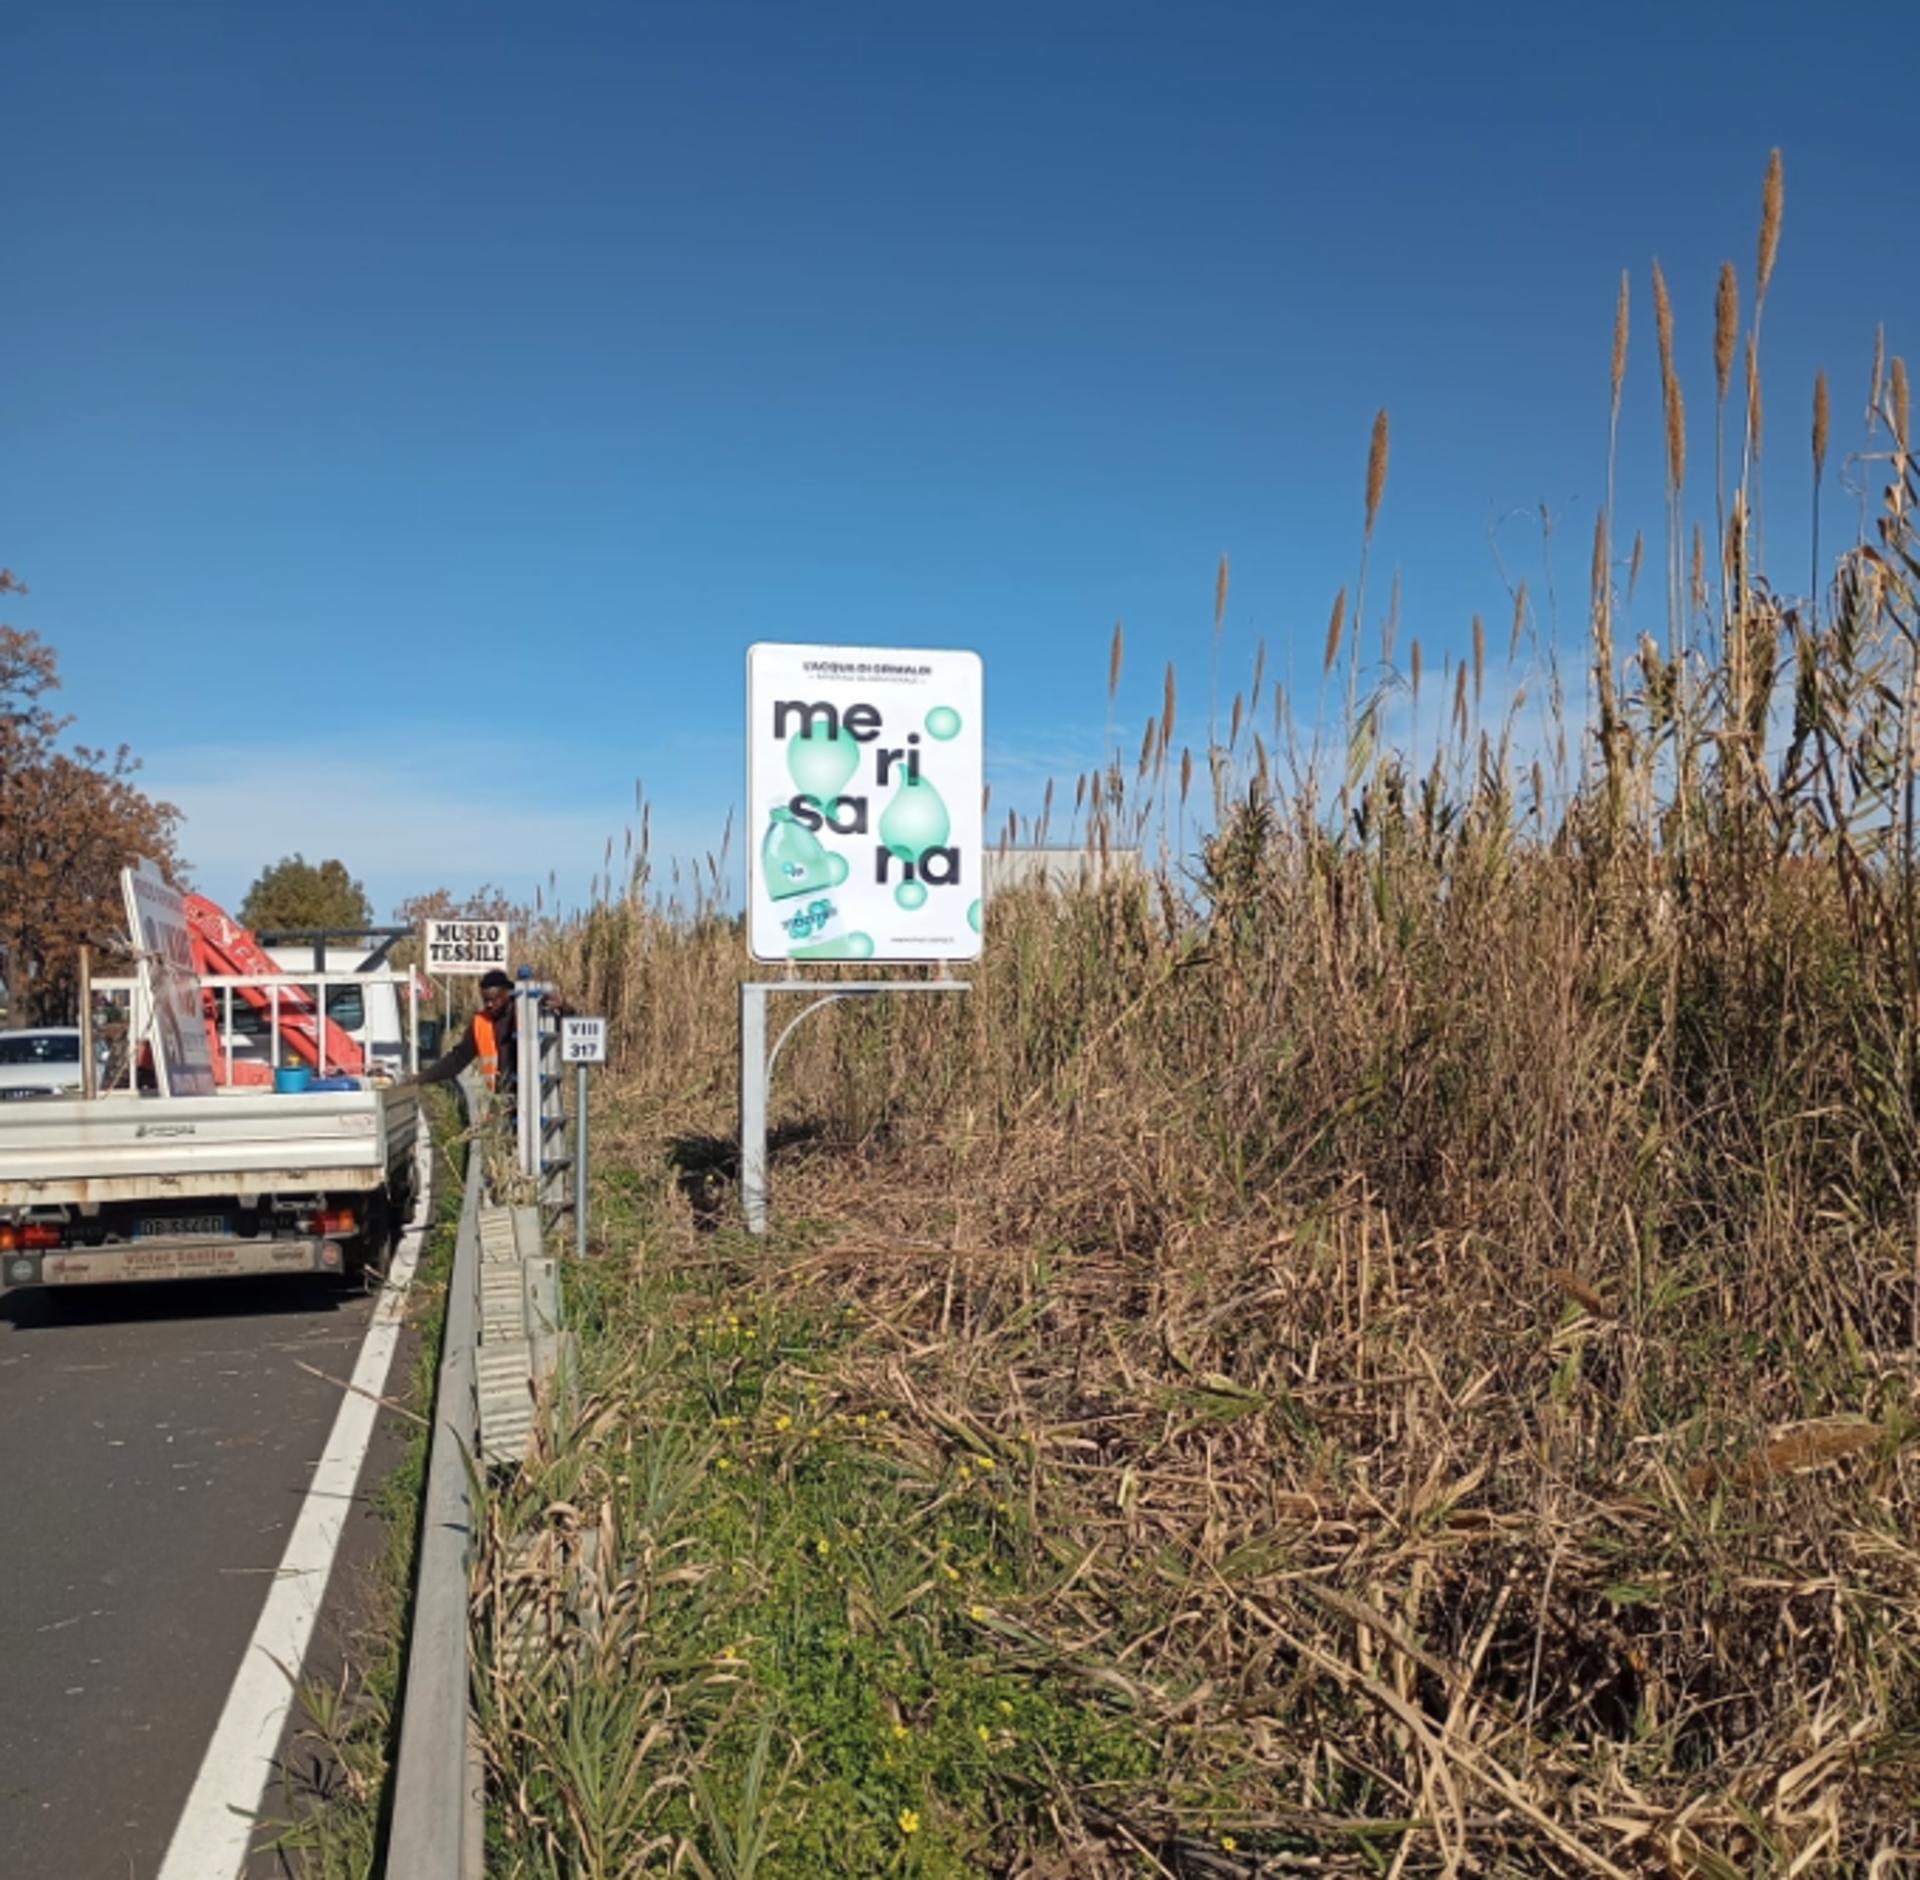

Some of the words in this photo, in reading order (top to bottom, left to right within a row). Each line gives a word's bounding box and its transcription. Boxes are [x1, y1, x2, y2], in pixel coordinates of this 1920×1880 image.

[774, 700, 883, 742] me
[876, 733, 920, 786] ri
[788, 794, 868, 834] sa
[876, 845, 960, 885] na
[435, 924, 500, 942] MUSEO
[430, 944, 505, 962] TESSILE
[568, 1022, 599, 1036] VIII
[570, 1043, 598, 1058] 317
